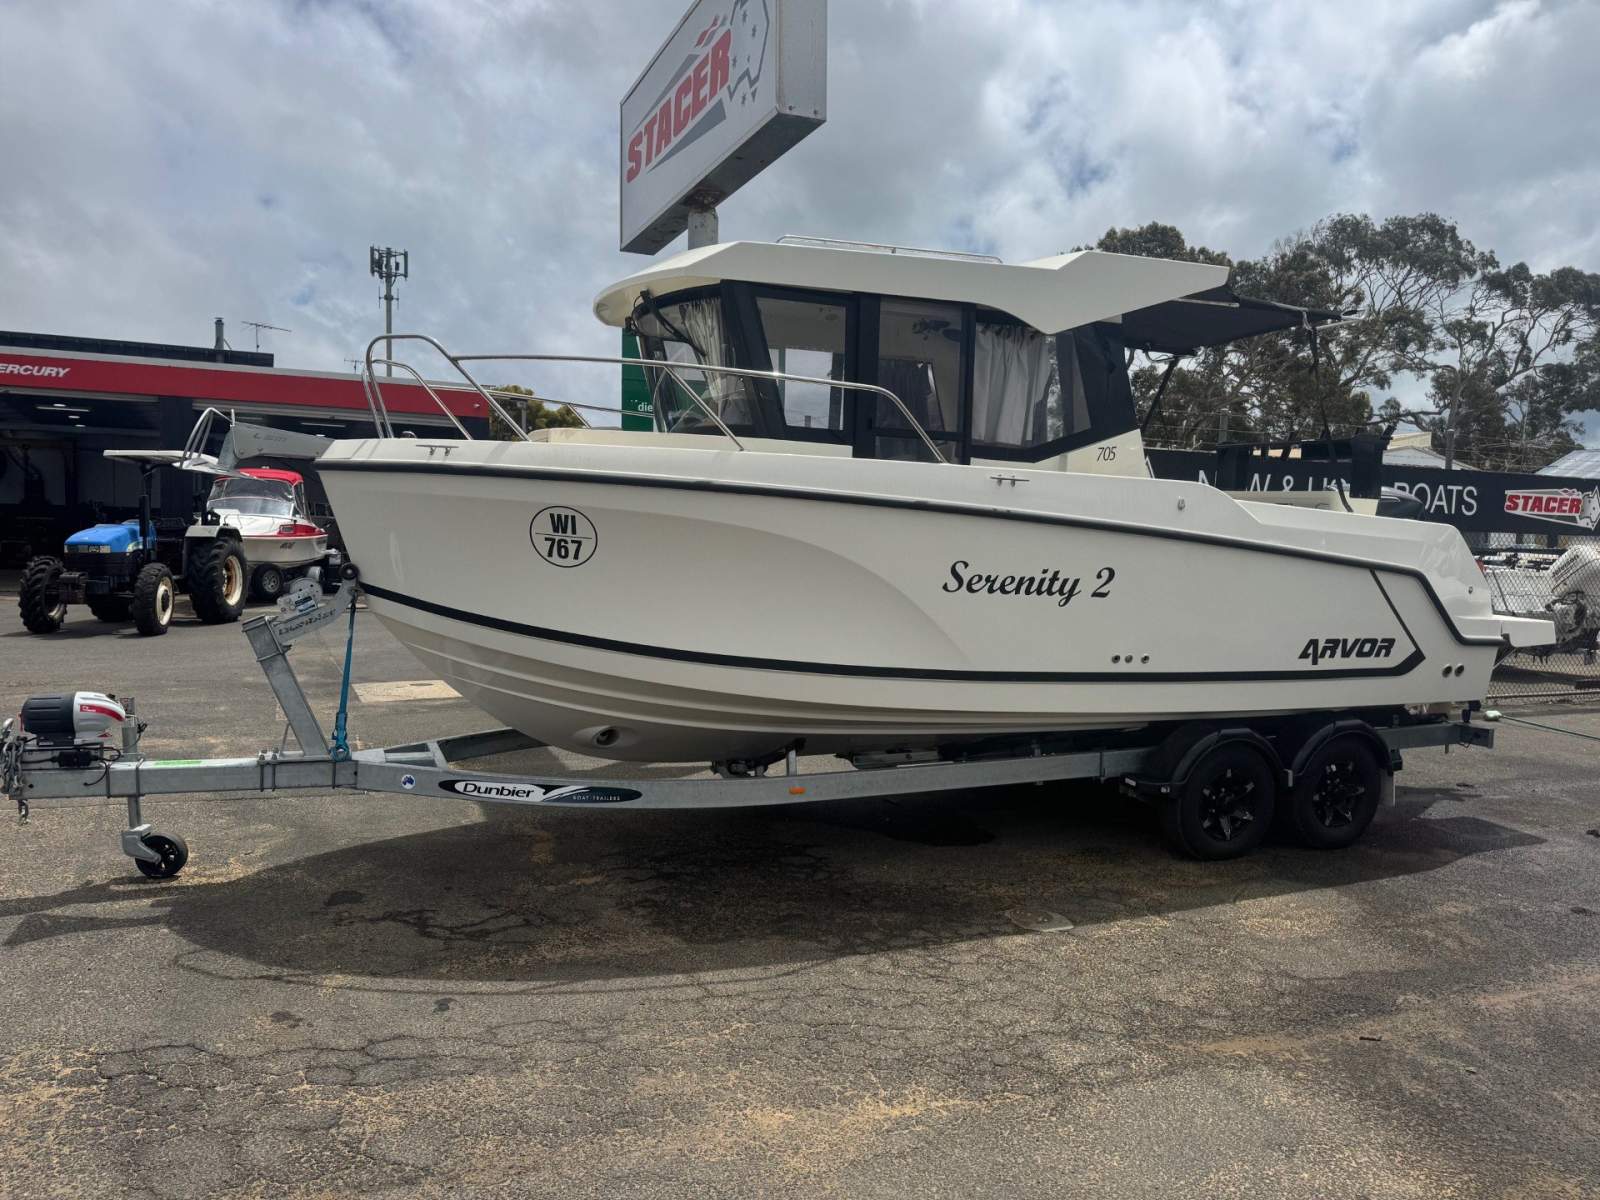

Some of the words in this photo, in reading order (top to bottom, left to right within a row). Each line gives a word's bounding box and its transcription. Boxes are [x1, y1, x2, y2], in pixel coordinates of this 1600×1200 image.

[627, 29, 732, 183] STACER
[0, 363, 71, 377] ERCURY
[637, 402, 654, 412] die
[1096, 446, 1117, 462] 705
[1505, 494, 1583, 514] STACER
[549, 512, 577, 535] WI
[544, 537, 582, 561] 767
[942, 560, 1082, 608] Serenity
[1090, 566, 1116, 599] 2
[1298, 638, 1396, 666] ARVOR
[462, 782, 535, 799] Dunbier
